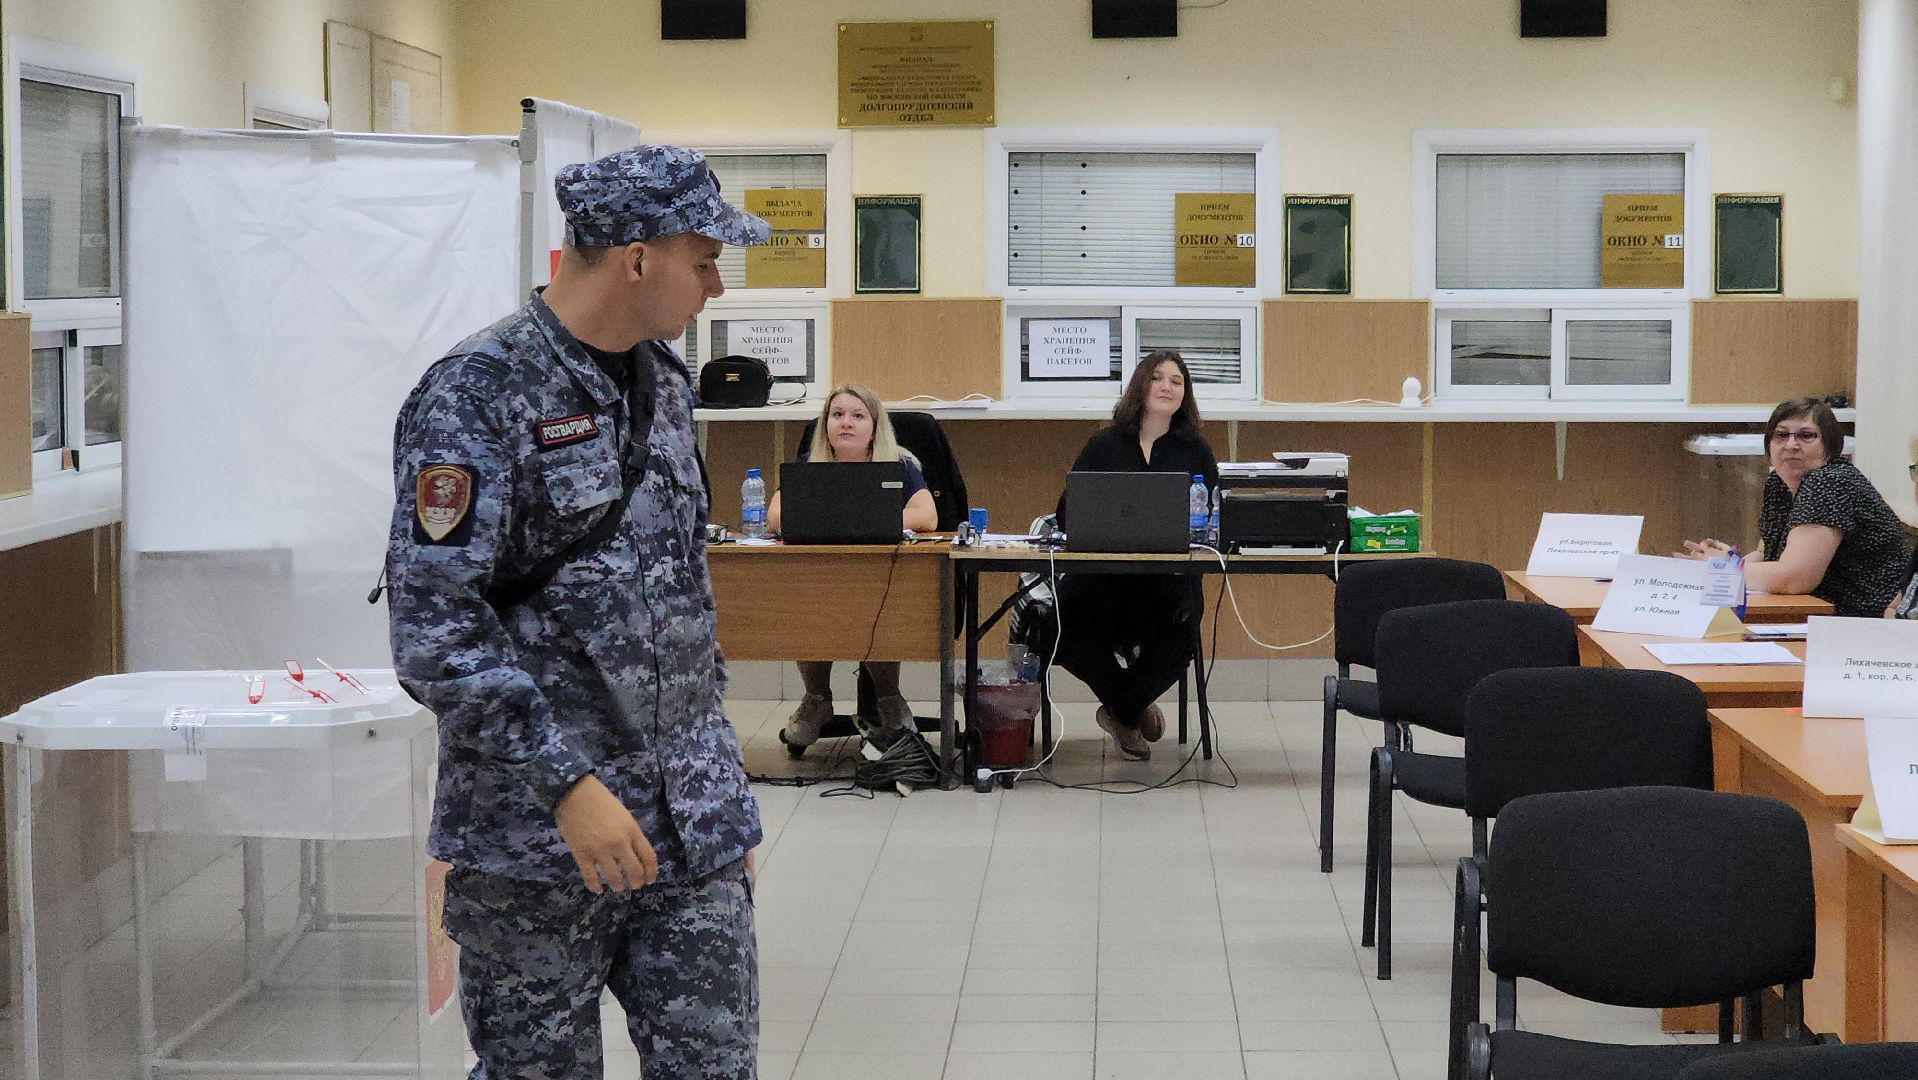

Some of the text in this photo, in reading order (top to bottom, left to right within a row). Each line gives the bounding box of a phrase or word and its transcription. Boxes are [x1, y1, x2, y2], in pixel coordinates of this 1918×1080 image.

[814, 237, 820, 247] 9
[1180, 235, 1219, 246] ОКНО
[1239, 236, 1253, 246] 10
[1607, 236, 1647, 247] ОКНО
[1668, 237, 1681, 247] 11
[752, 346, 782, 354] СЕЙФ-
[542, 419, 592, 439] РОСГВАРДИЯ
[1648, 578, 1705, 591] Молодежная
[1648, 606, 1681, 616] Южная
[1844, 657, 1913, 669] Лихачевское
